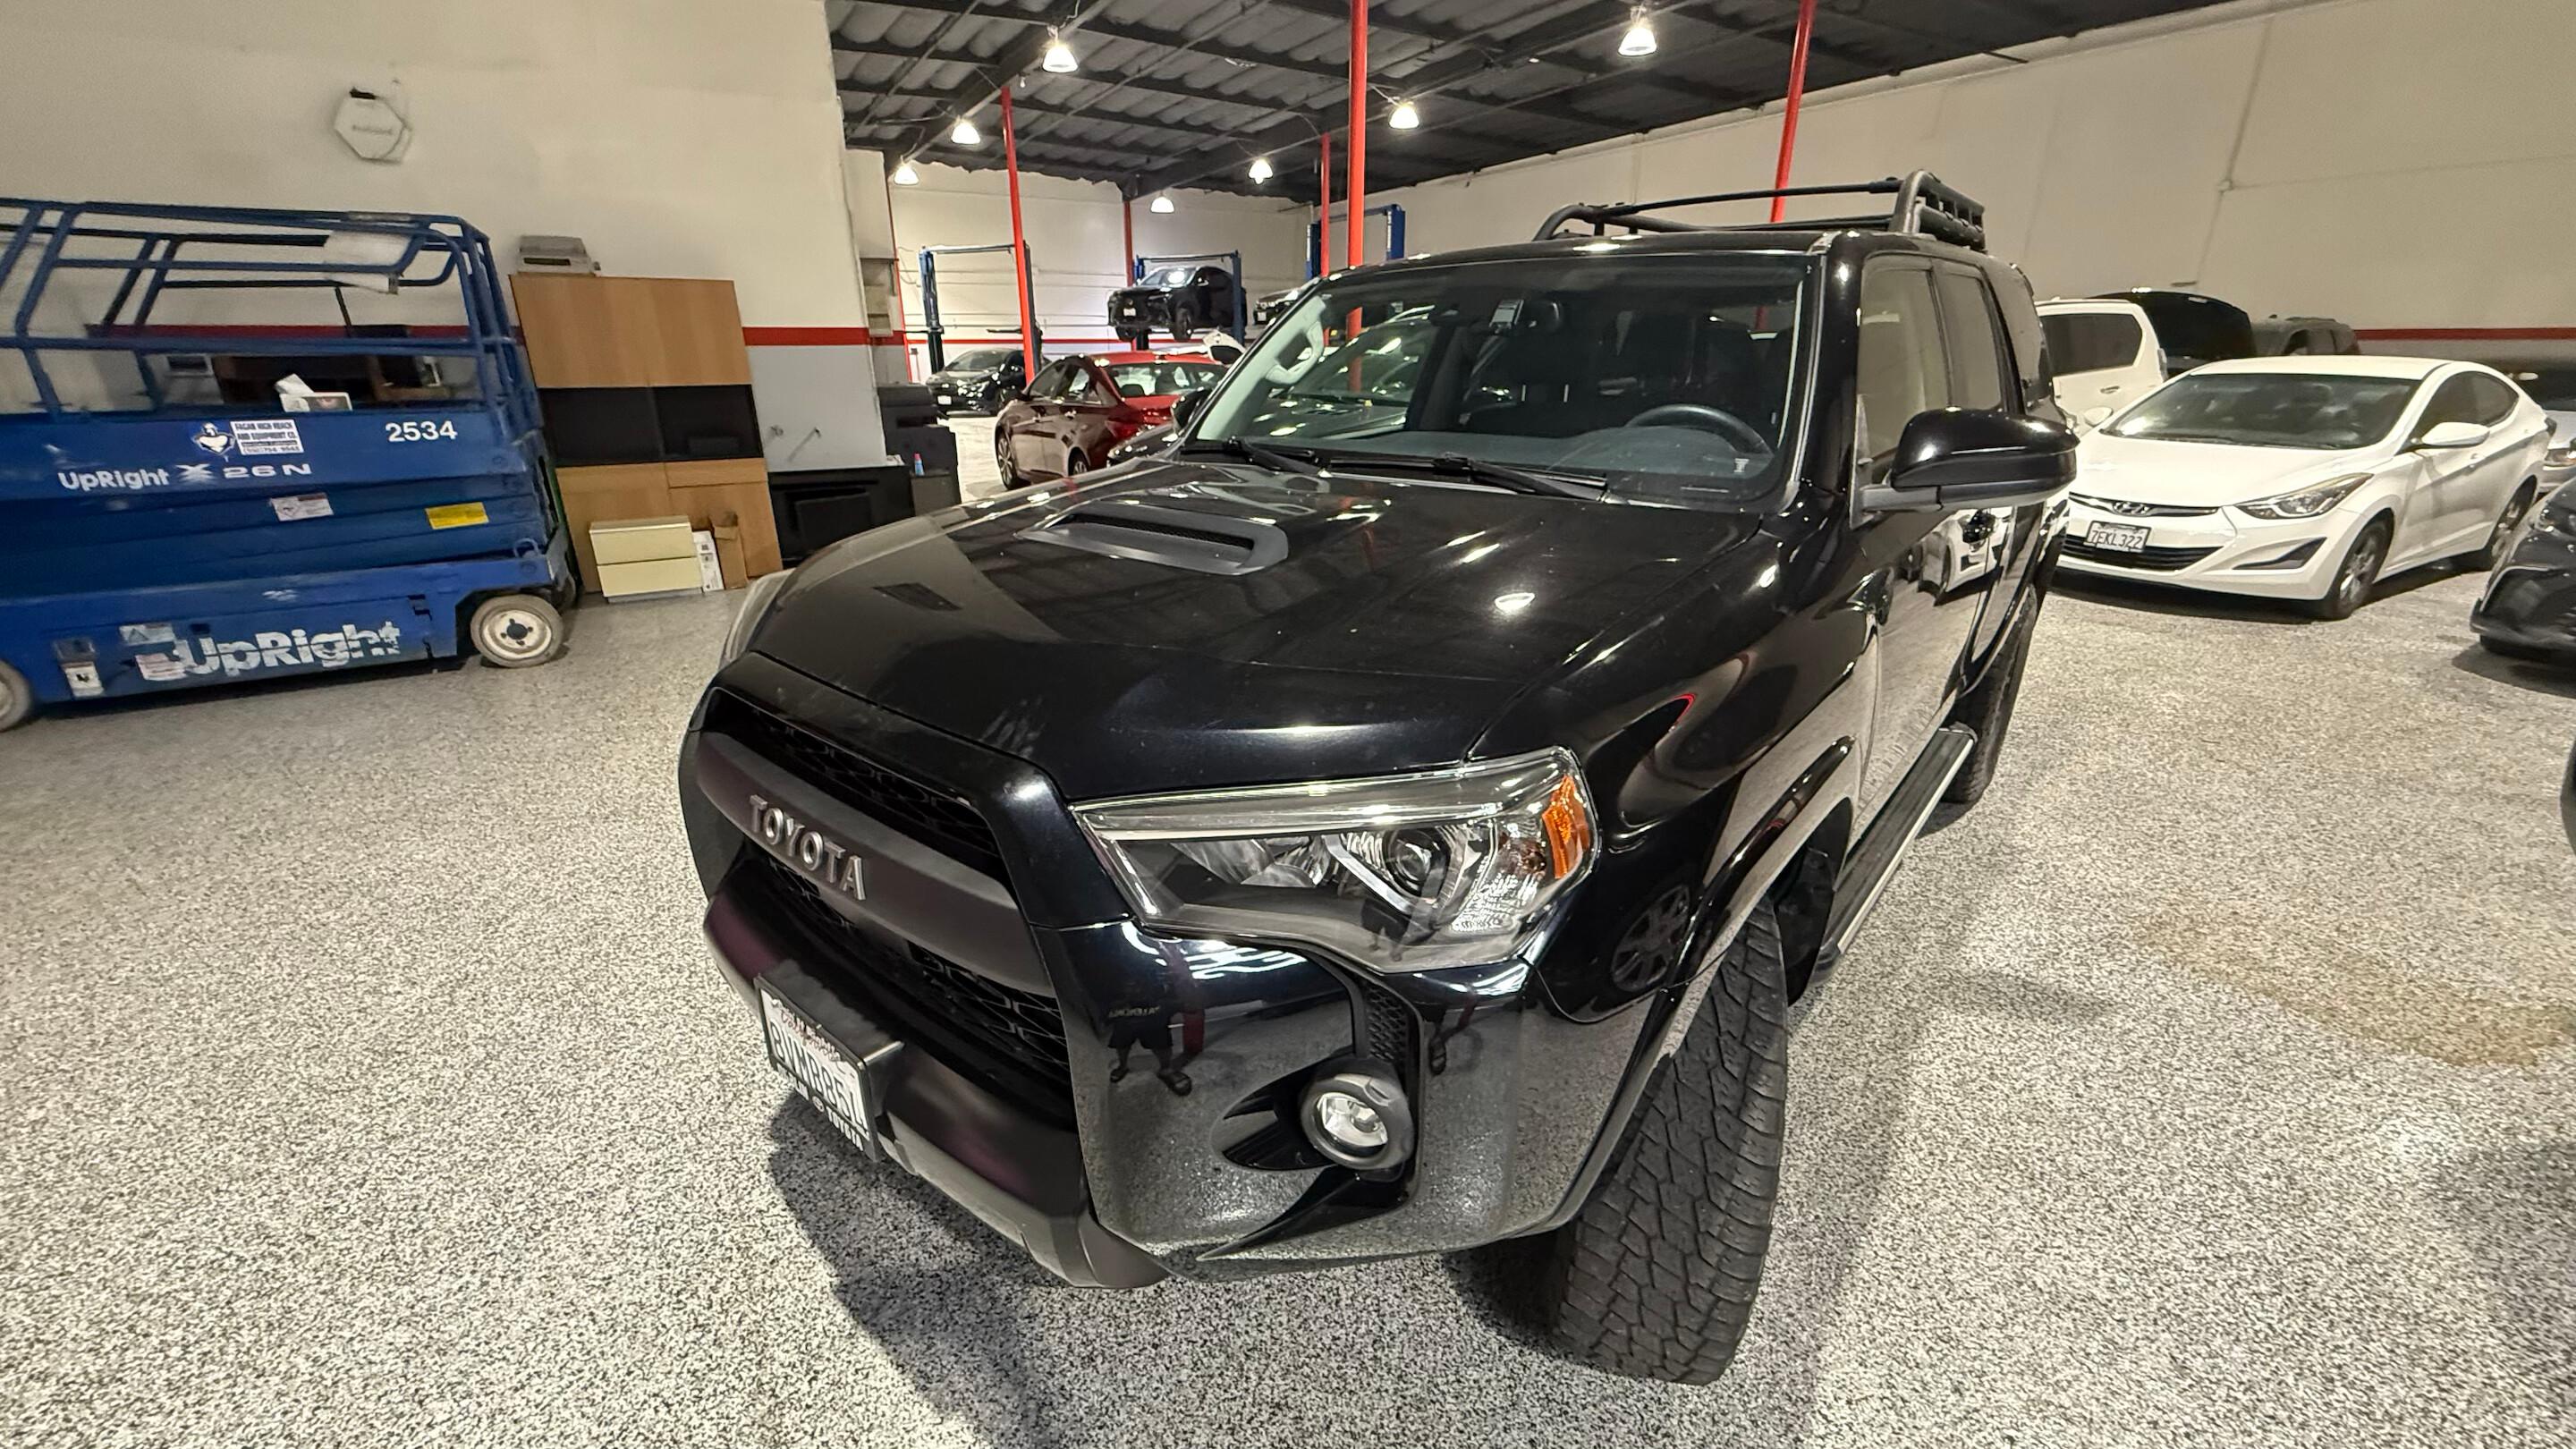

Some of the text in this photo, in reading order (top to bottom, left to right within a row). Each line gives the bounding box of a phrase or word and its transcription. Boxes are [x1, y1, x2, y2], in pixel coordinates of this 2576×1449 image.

[386, 420, 458, 442] 2534
[57, 468, 169, 491] UpRight
[2090, 530, 2143, 549] 7EKL322
[182, 622, 400, 676] UpRight
[750, 794, 867, 901] TOYOTA
[826, 1106, 863, 1151] TOYOTA
